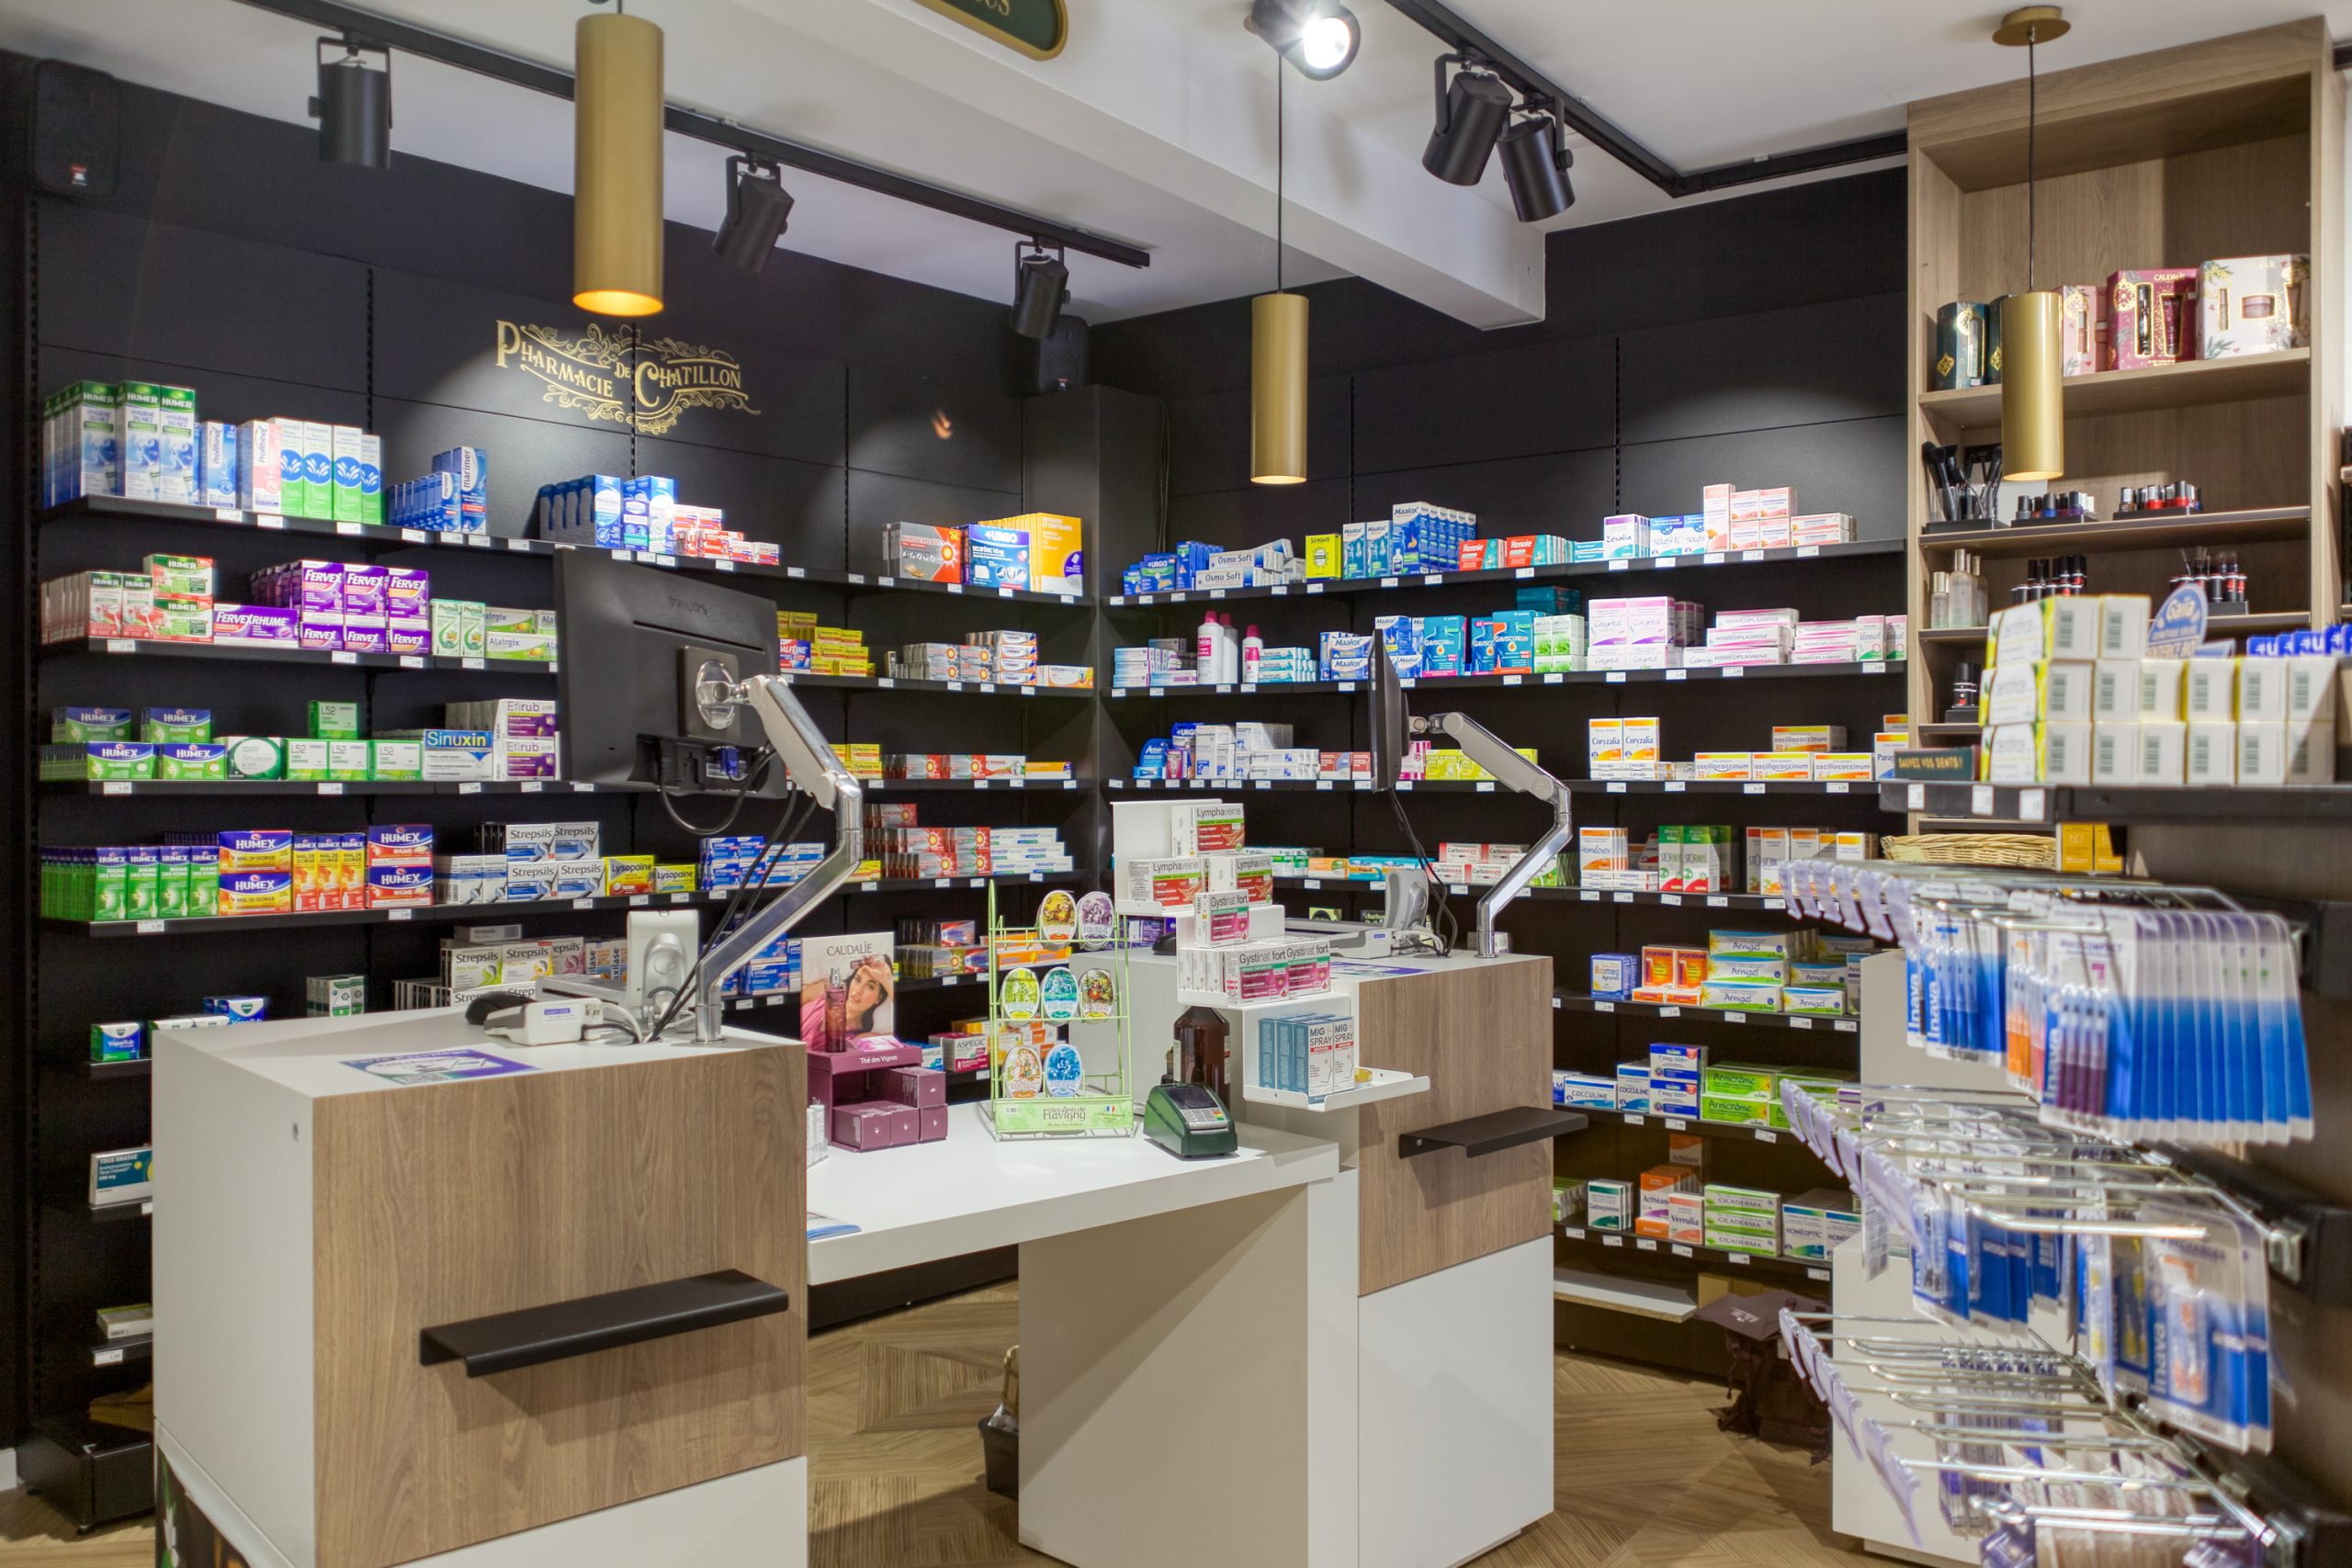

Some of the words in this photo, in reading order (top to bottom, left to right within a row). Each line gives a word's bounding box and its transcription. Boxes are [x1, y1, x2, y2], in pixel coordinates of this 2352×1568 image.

[495, 320, 614, 397] PHARMACIE
[615, 362, 631, 379] DE
[635, 361, 741, 408] CHATILLON
[162, 398, 192, 408] HUMER
[463, 449, 471, 488] marimer
[1394, 506, 1419, 515] Maalox
[1464, 544, 1483, 552] Rennie
[1511, 539, 1532, 548] Rennie
[1238, 554, 1252, 562] Soft
[305, 570, 342, 582] FERVEX
[346, 574, 383, 586] FERVEX
[1205, 573, 1224, 581] Osmo
[1226, 572, 1240, 581] Soft
[391, 577, 426, 590] FERVEX
[303, 628, 336, 639] FERVEX
[347, 631, 379, 643] FERVEX
[394, 634, 424, 644] FERVEX
[490, 637, 520, 647] Alairgix
[1335, 637, 1362, 648] Maalox
[1335, 660, 1362, 669] Maalox
[322, 706, 335, 716] L52
[507, 702, 539, 712] Efirub
[81, 714, 116, 722] HUMEX
[164, 714, 197, 723] HUMEX
[427, 731, 486, 747] Sinuxin
[1592, 738, 1620, 746] Coryzalia
[1625, 737, 1654, 745] Coryzalia
[291, 745, 306, 753] L52
[332, 746, 345, 754] L52
[380, 747, 394, 755] L52
[507, 742, 539, 751] Efirub
[103, 749, 138, 758] HUMEX
[176, 750, 210, 758] HUMEX
[1197, 807, 1240, 818] Lymphaveine
[511, 829, 551, 840] Strepsils
[555, 827, 595, 837] Strepsils
[381, 833, 420, 843] HUMEX
[236, 840, 276, 849] HUMEX
[1153, 863, 1199, 873] Lymphaveine
[1238, 858, 1271, 869] Lymphaveine
[513, 866, 554, 877] Strepsils
[561, 864, 601, 874] Strepsils
[381, 874, 420, 885] HUMEX
[235, 881, 275, 890] HUMEX
[1237, 895, 1248, 904] fort
[1287, 948, 1315, 959] Gystinat
[1317, 944, 1329, 954] fort
[1734, 942, 1760, 951] Arnigel
[457, 952, 499, 964] Strepsils
[506, 947, 548, 959] Strepsils
[1239, 953, 1270, 964] Gystinat
[1272, 951, 1285, 960] fort
[1595, 965, 1619, 976] Biomag
[1732, 967, 1758, 976] Arnigel
[1806, 974, 1830, 982] Arnigel
[1724, 994, 1751, 1003] Arnigel
[1927, 981, 1939, 1042] Inava
[1310, 1028, 1325, 1037] MIG
[1335, 1024, 1348, 1033] MIG
[1310, 1036, 1332, 1046] SPRAY
[1335, 1032, 1353, 1043] SPRAY
[1043, 1109, 1086, 1122] Flavigny
[1718, 1198, 1761, 1208] CICADERMA
[1670, 1214, 1699, 1225] Verrulia
[1718, 1217, 1760, 1228] CICADERMA
[1719, 1236, 1761, 1247] CICADERMA
